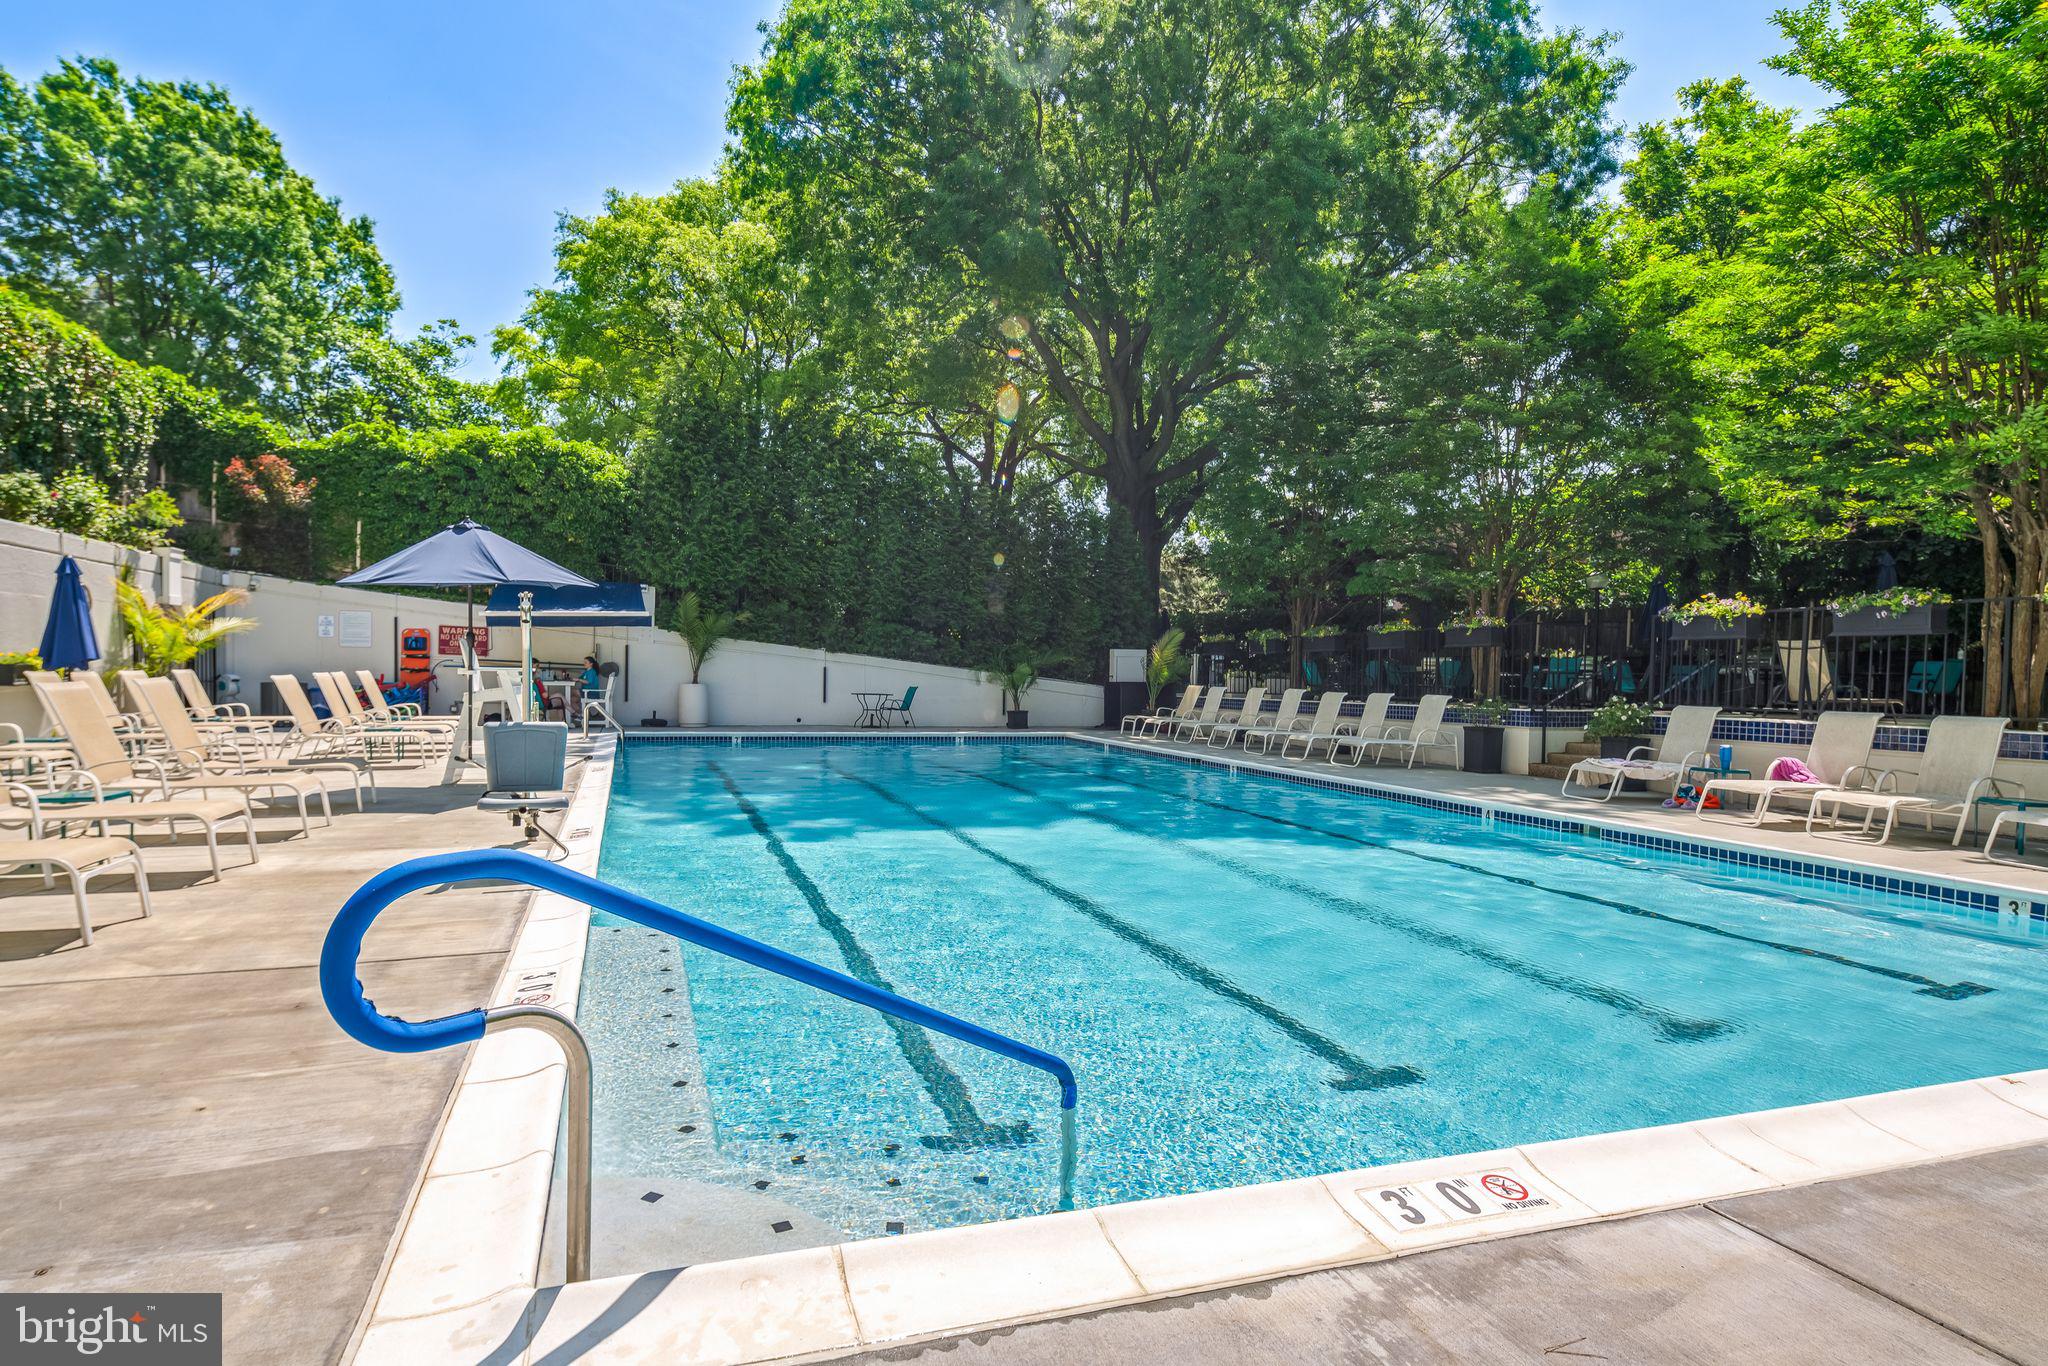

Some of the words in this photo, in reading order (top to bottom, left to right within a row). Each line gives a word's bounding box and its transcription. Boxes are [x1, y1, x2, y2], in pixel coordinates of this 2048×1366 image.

[442, 627, 486, 635] WARNNG
[1380, 1191, 1426, 1224] 3
[1436, 1182, 1481, 1214] 0
[1502, 1202, 1519, 1211] NO
[1517, 1198, 1550, 1210] DIVING
